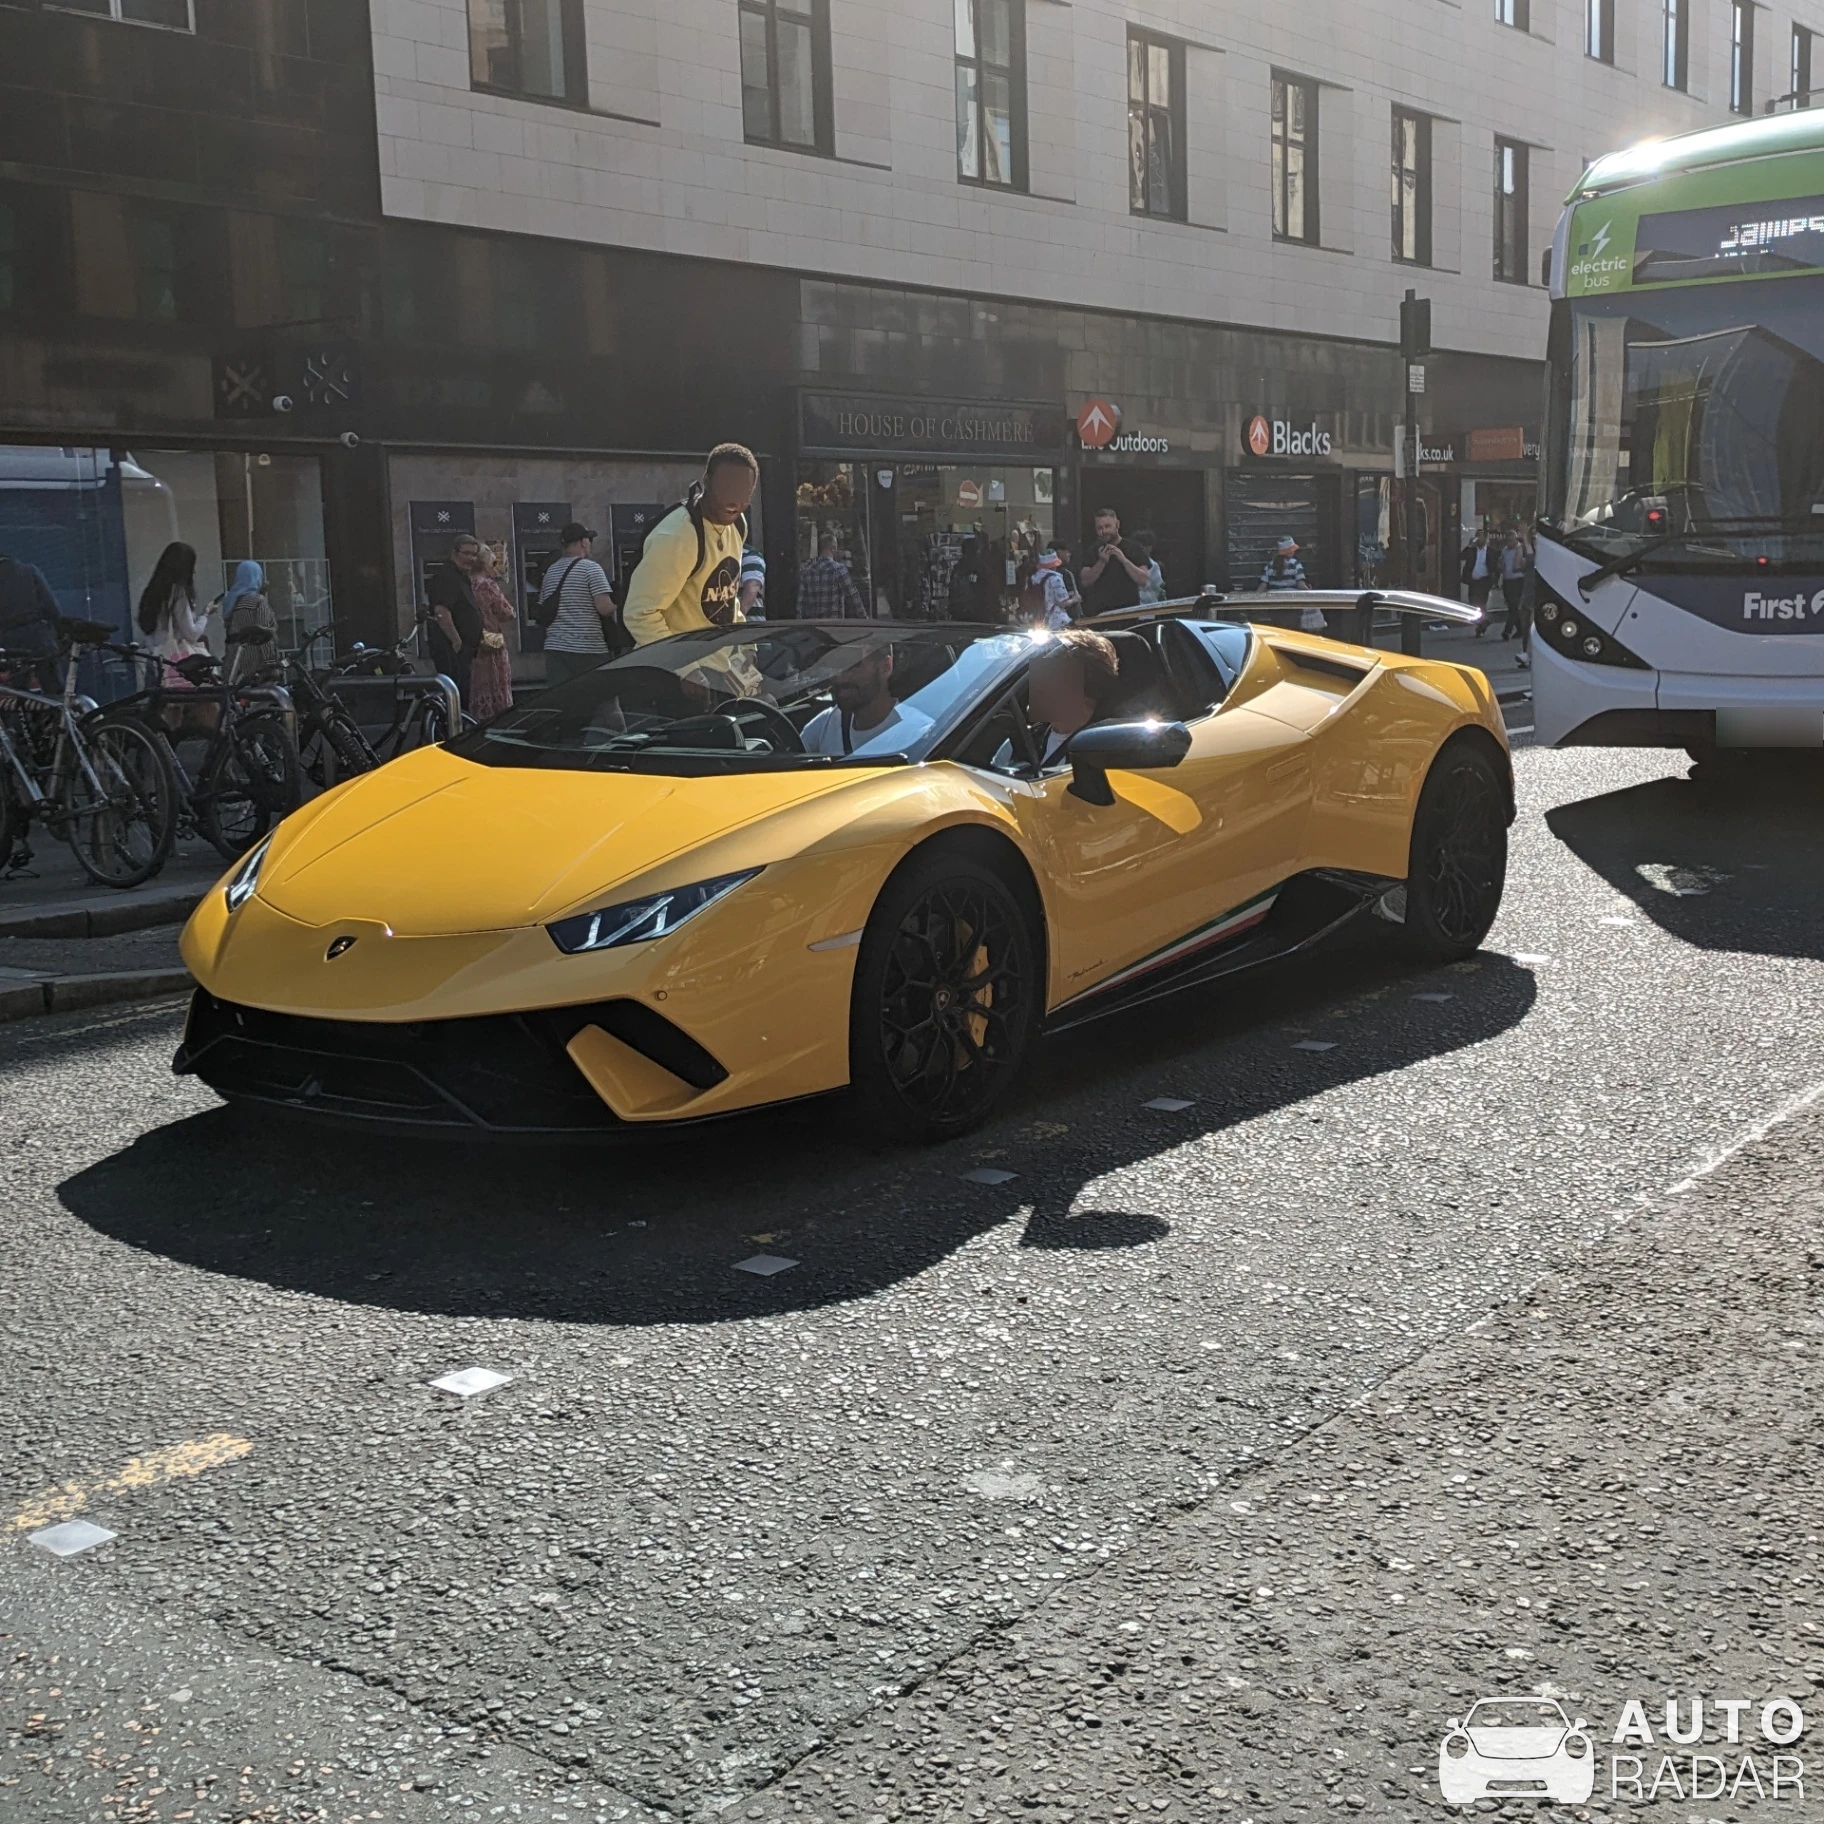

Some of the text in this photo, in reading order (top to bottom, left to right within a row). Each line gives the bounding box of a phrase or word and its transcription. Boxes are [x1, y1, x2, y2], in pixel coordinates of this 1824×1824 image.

[1571, 258, 1627, 275] electric
[1584, 274, 1610, 288] bus
[838, 413, 1034, 443] HOUSE OF CASHMERE
[1273, 420, 1331, 455] Blacks
[1743, 592, 1806, 620] First
